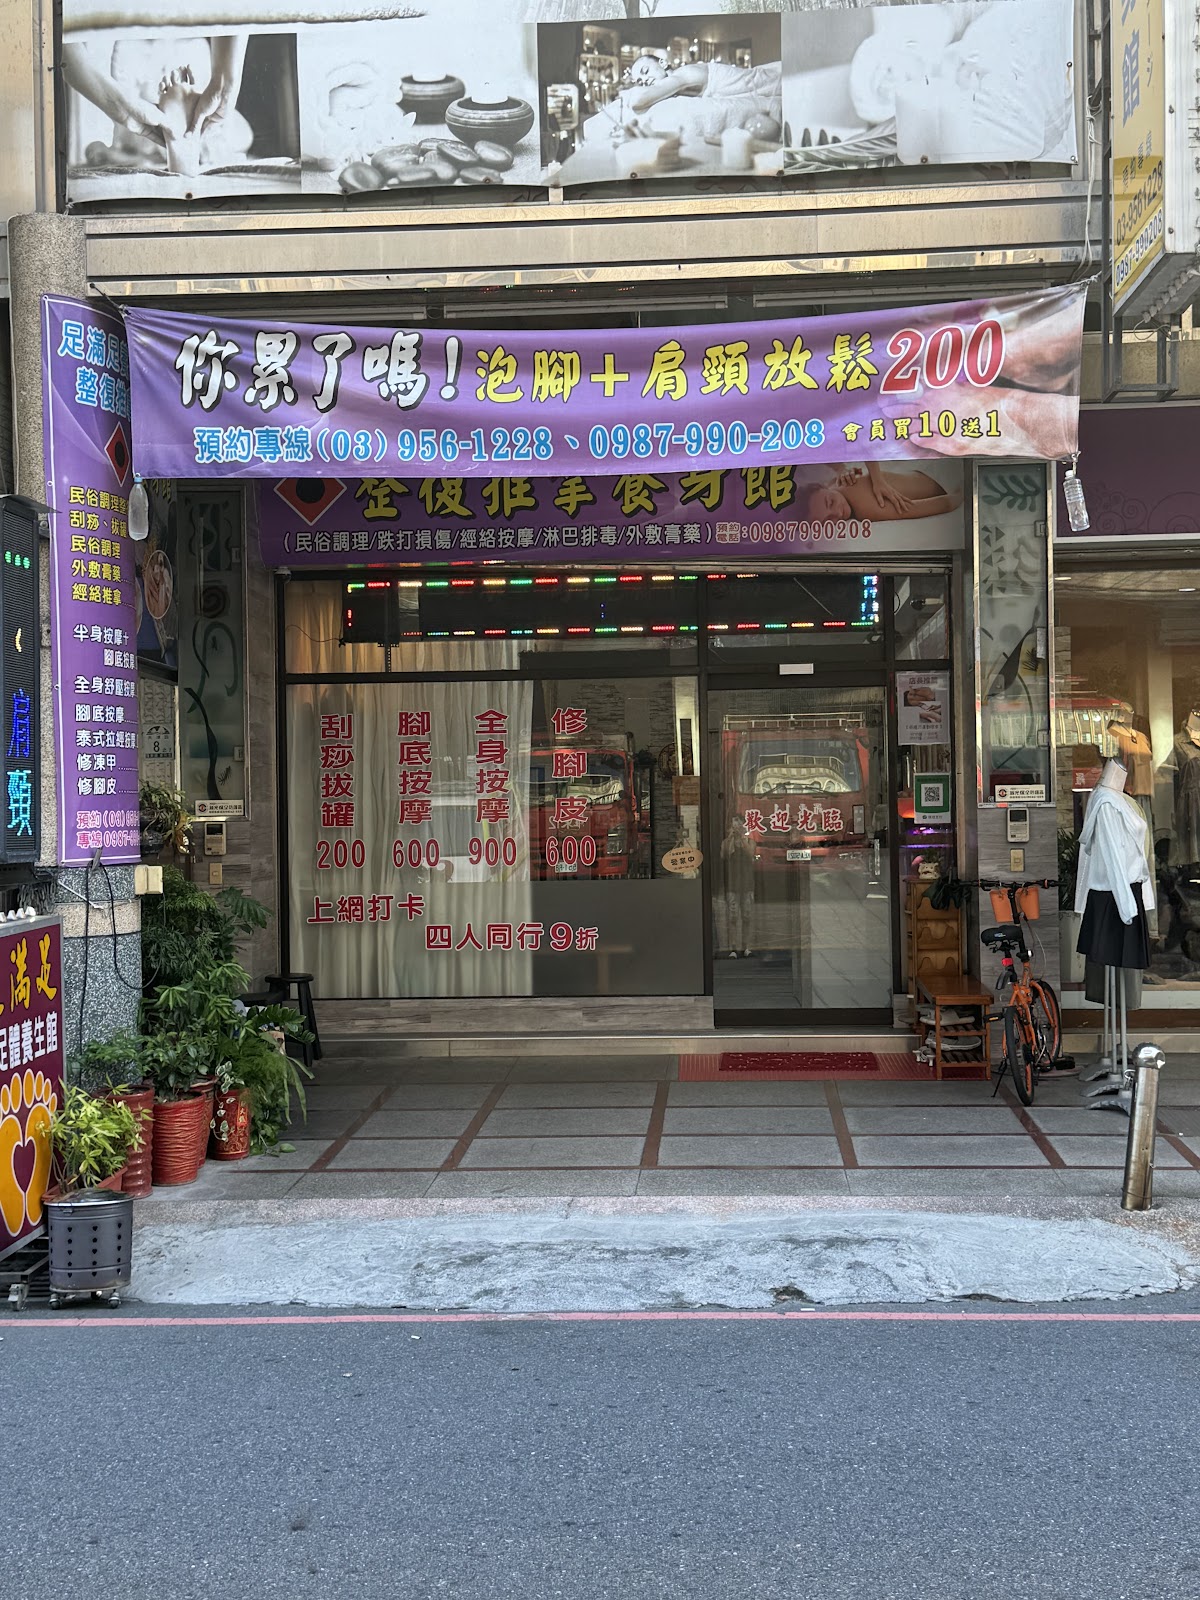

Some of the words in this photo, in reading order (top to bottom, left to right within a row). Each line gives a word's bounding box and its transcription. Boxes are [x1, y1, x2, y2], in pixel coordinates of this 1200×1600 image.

[1115, 159, 1164, 247] 03-9561228
[1115, 207, 1164, 288] 0987-990208
[70, 535, 121, 560] 民俗調理
[71, 558, 122, 583] 外敷膏藥
[71, 582, 122, 606] 經絡推拿
[74, 675, 136, 698] 全身舒壓按摩
[74, 704, 125, 724] 腳底按摩
[76, 754, 117, 773] 修凍甲
[320, 713, 354, 828] 刮痧拔罐
[397, 711, 433, 826] 腳底按摩
[474, 709, 510, 824] 全身按摩
[551, 707, 589, 824] 修腳皮
[77, 777, 117, 796] 修腳皮
[743, 808, 844, 833] 歡迎光臨
[316, 838, 366, 870] 200
[392, 837, 440, 868] 600
[468, 836, 518, 868] 900
[545, 834, 597, 868] 600
[306, 892, 426, 924] 上網打卡
[425, 921, 600, 952] 四人同行9折
[0, 932, 58, 1015] 滿足
